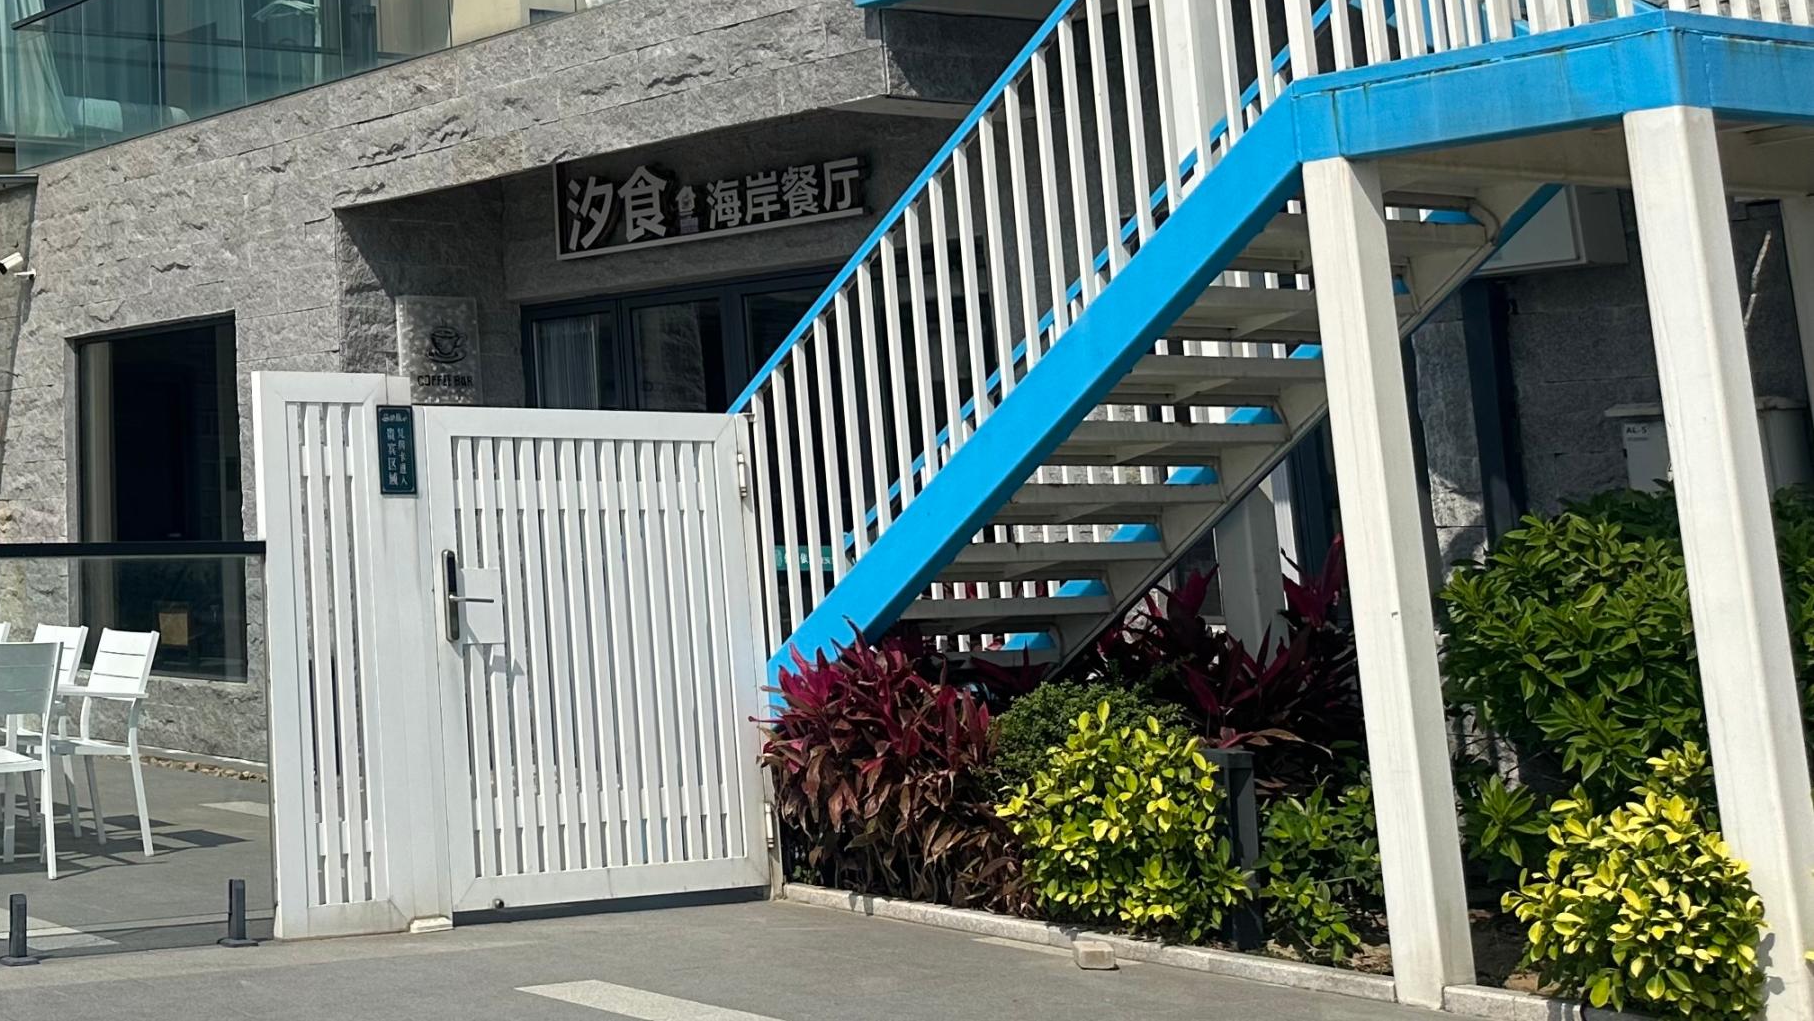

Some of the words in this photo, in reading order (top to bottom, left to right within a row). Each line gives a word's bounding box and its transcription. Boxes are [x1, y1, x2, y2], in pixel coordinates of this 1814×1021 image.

[567, 165, 667, 251] 汐食
[706, 156, 860, 230] 海岸餐厅
